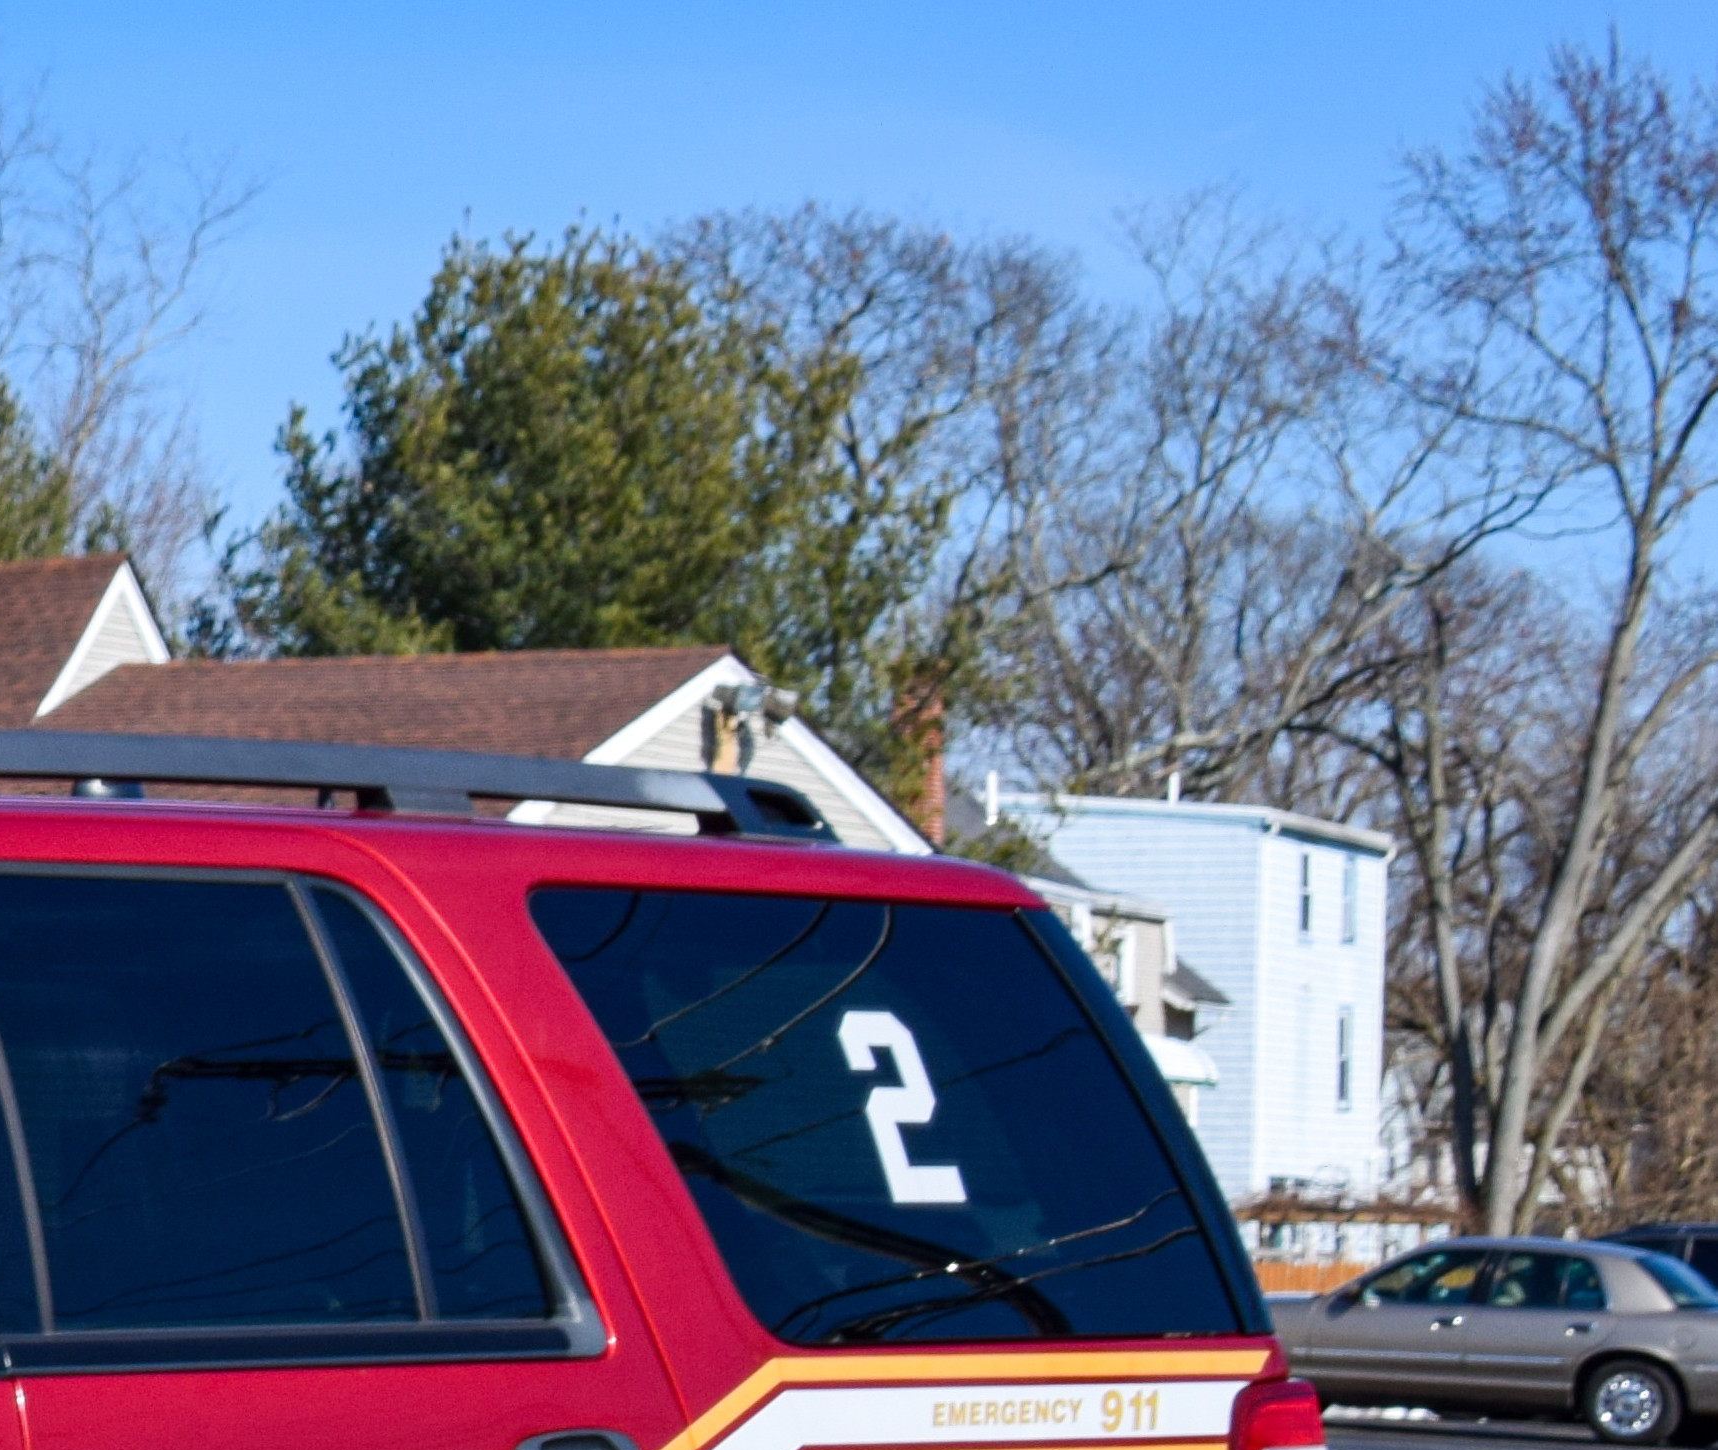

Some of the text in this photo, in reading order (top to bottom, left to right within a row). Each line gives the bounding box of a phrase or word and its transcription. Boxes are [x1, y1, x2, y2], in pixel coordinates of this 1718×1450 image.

[837, 1011, 968, 1204] 2
[931, 1389, 1160, 1432] EMERGENCY 911
